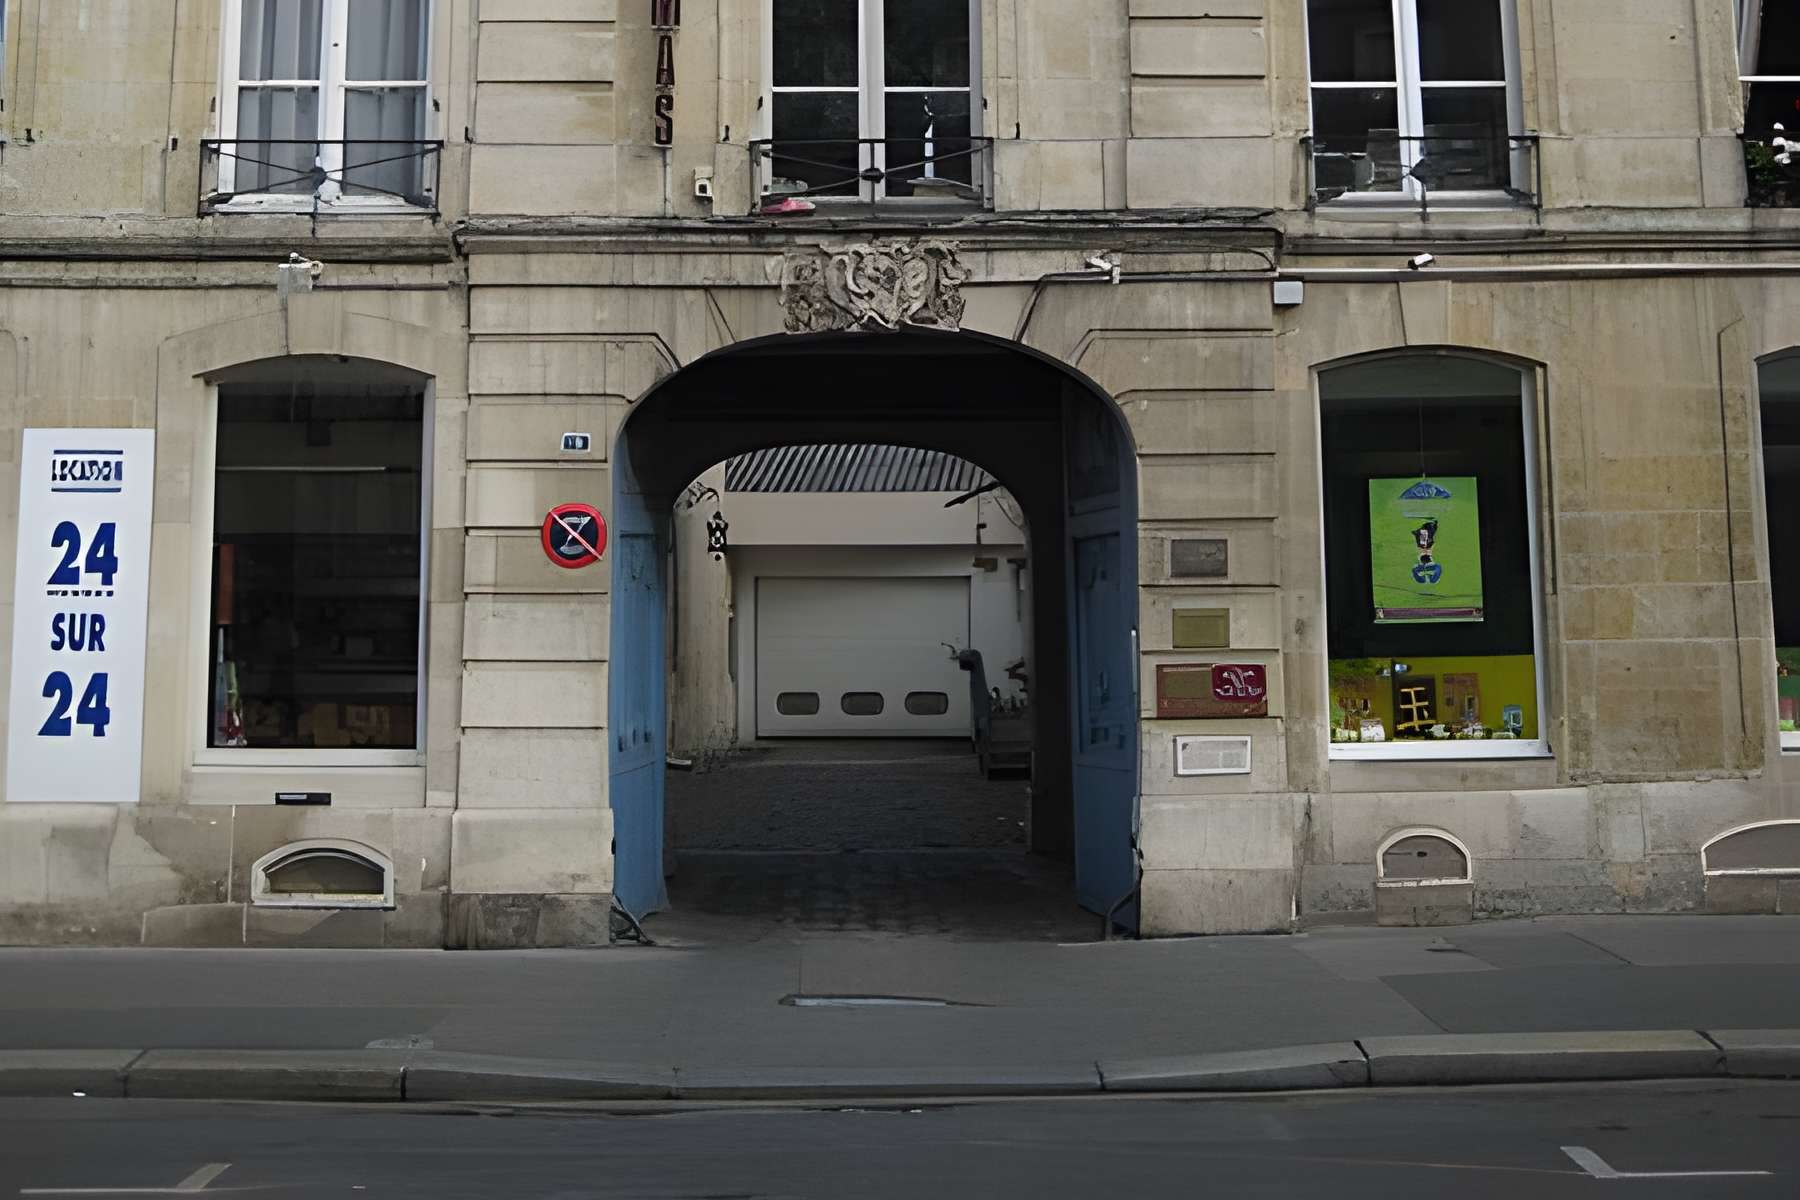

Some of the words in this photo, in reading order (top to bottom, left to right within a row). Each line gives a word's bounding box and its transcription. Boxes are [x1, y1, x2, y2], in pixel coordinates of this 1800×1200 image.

[47, 521, 118, 586] 24
[51, 612, 106, 652] SUR
[38, 670, 111, 737] 24
